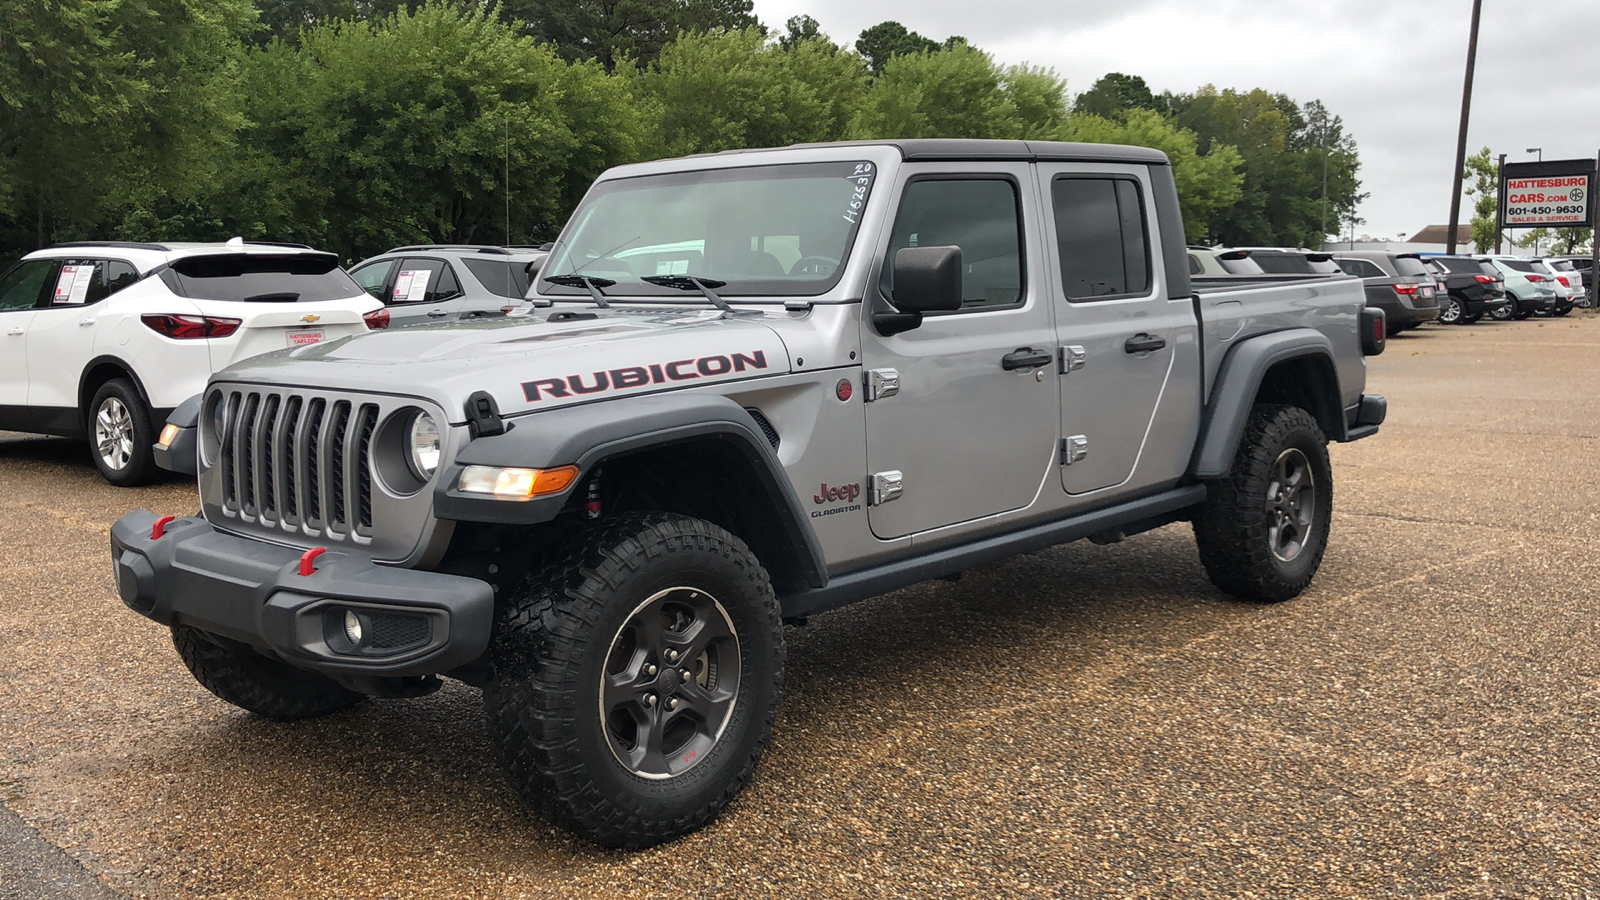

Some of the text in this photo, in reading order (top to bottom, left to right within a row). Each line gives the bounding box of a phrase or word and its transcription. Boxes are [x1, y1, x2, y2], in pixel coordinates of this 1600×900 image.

[853, 163, 872, 175] 20
[1508, 178, 1586, 189] HATTIESBURG
[1508, 205, 1584, 215] 601-450-9630
[520, 350, 768, 403] RUBICON
[814, 482, 861, 505] Jeep
[811, 504, 861, 518] GLADIATOR
